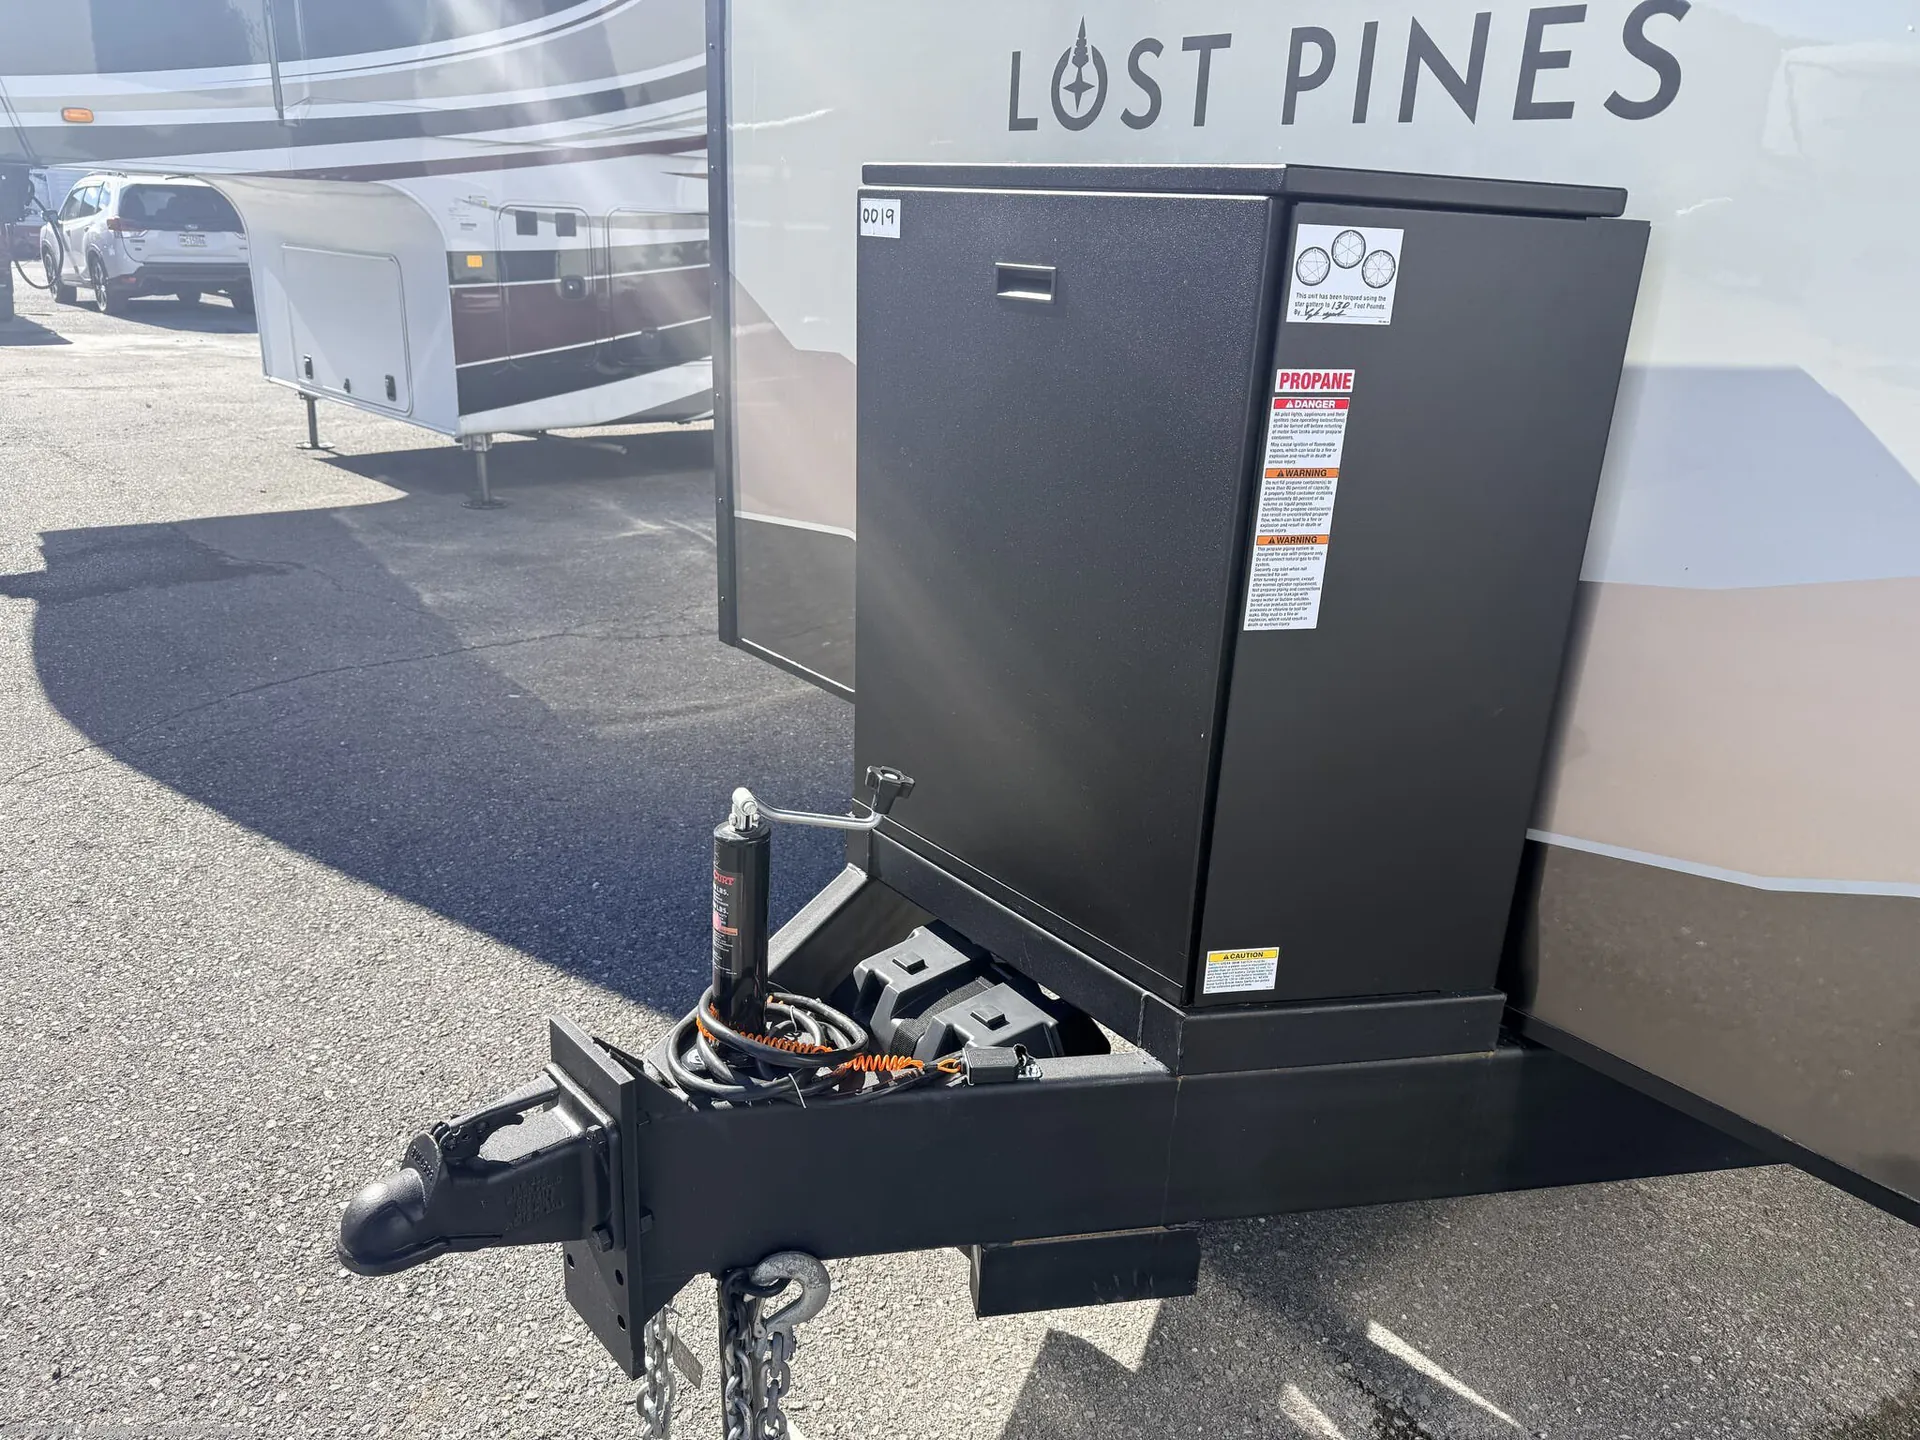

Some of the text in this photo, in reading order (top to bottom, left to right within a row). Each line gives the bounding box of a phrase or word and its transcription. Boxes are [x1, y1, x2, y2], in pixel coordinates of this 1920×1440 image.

[1008, 0, 1691, 132] LOST PINES
[863, 208, 895, 226] 0019
[1279, 372, 1352, 390] PROPANE
[1294, 400, 1336, 409] DANGER
[1285, 469, 1327, 477] WARNING
[1277, 536, 1317, 544] WARNING
